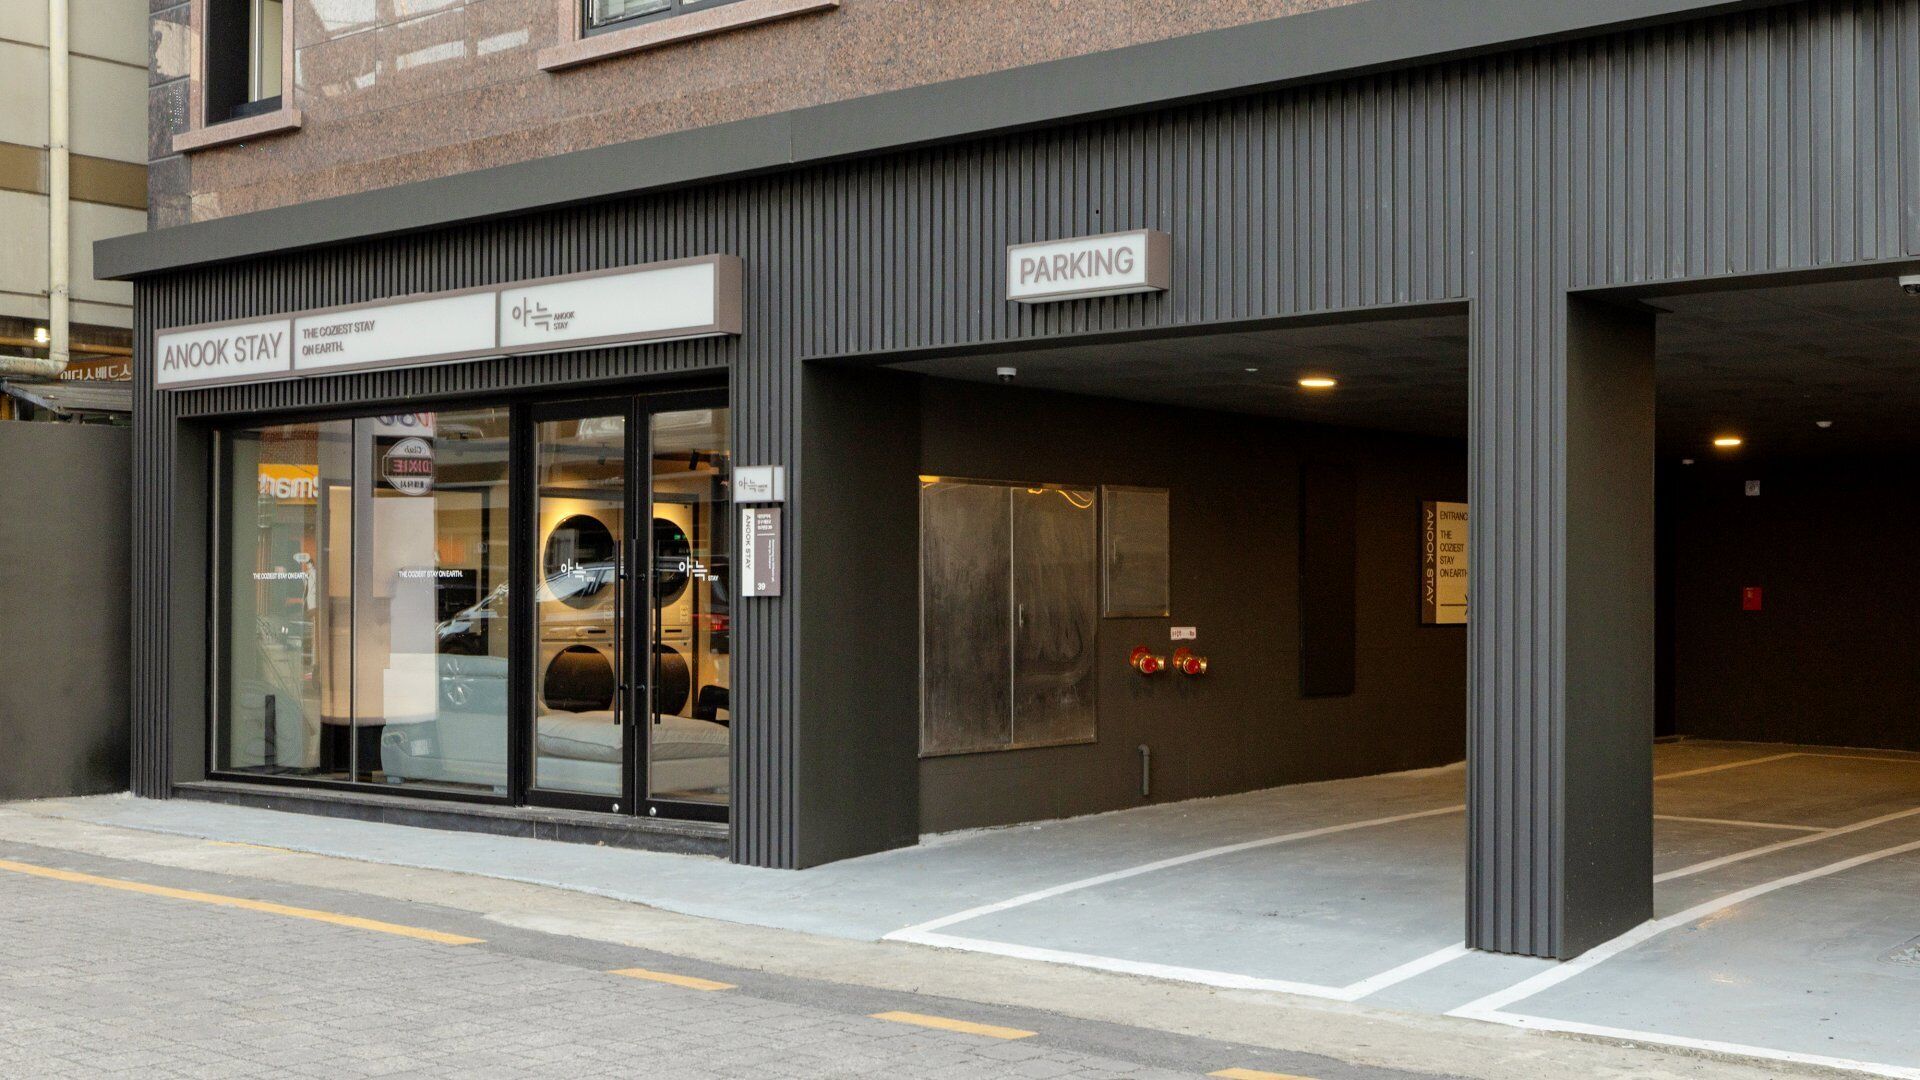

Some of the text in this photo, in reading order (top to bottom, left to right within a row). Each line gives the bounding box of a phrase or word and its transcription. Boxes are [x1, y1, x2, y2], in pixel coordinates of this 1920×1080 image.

[1020, 246, 1134, 284] PARKING
[512, 297, 552, 331] 아늑
[554, 311, 575, 320] ANOOK
[302, 320, 375, 339] THE COZIEST STAY
[554, 321, 568, 330] STAY
[163, 332, 283, 370] ANOOK STAY
[302, 345, 314, 356] ON
[1440, 511, 1468, 521] ENTRANC
[1440, 530, 1452, 539] THE
[1440, 543, 1464, 552] COZIEST
[1426, 509, 1434, 605] ANOOK STAY
[1440, 556, 1454, 564] STAY
[560, 558, 587, 582] 아늑
[678, 556, 708, 581] 아늑
[1440, 569, 1449, 578] ON
[757, 582, 766, 591] 39
